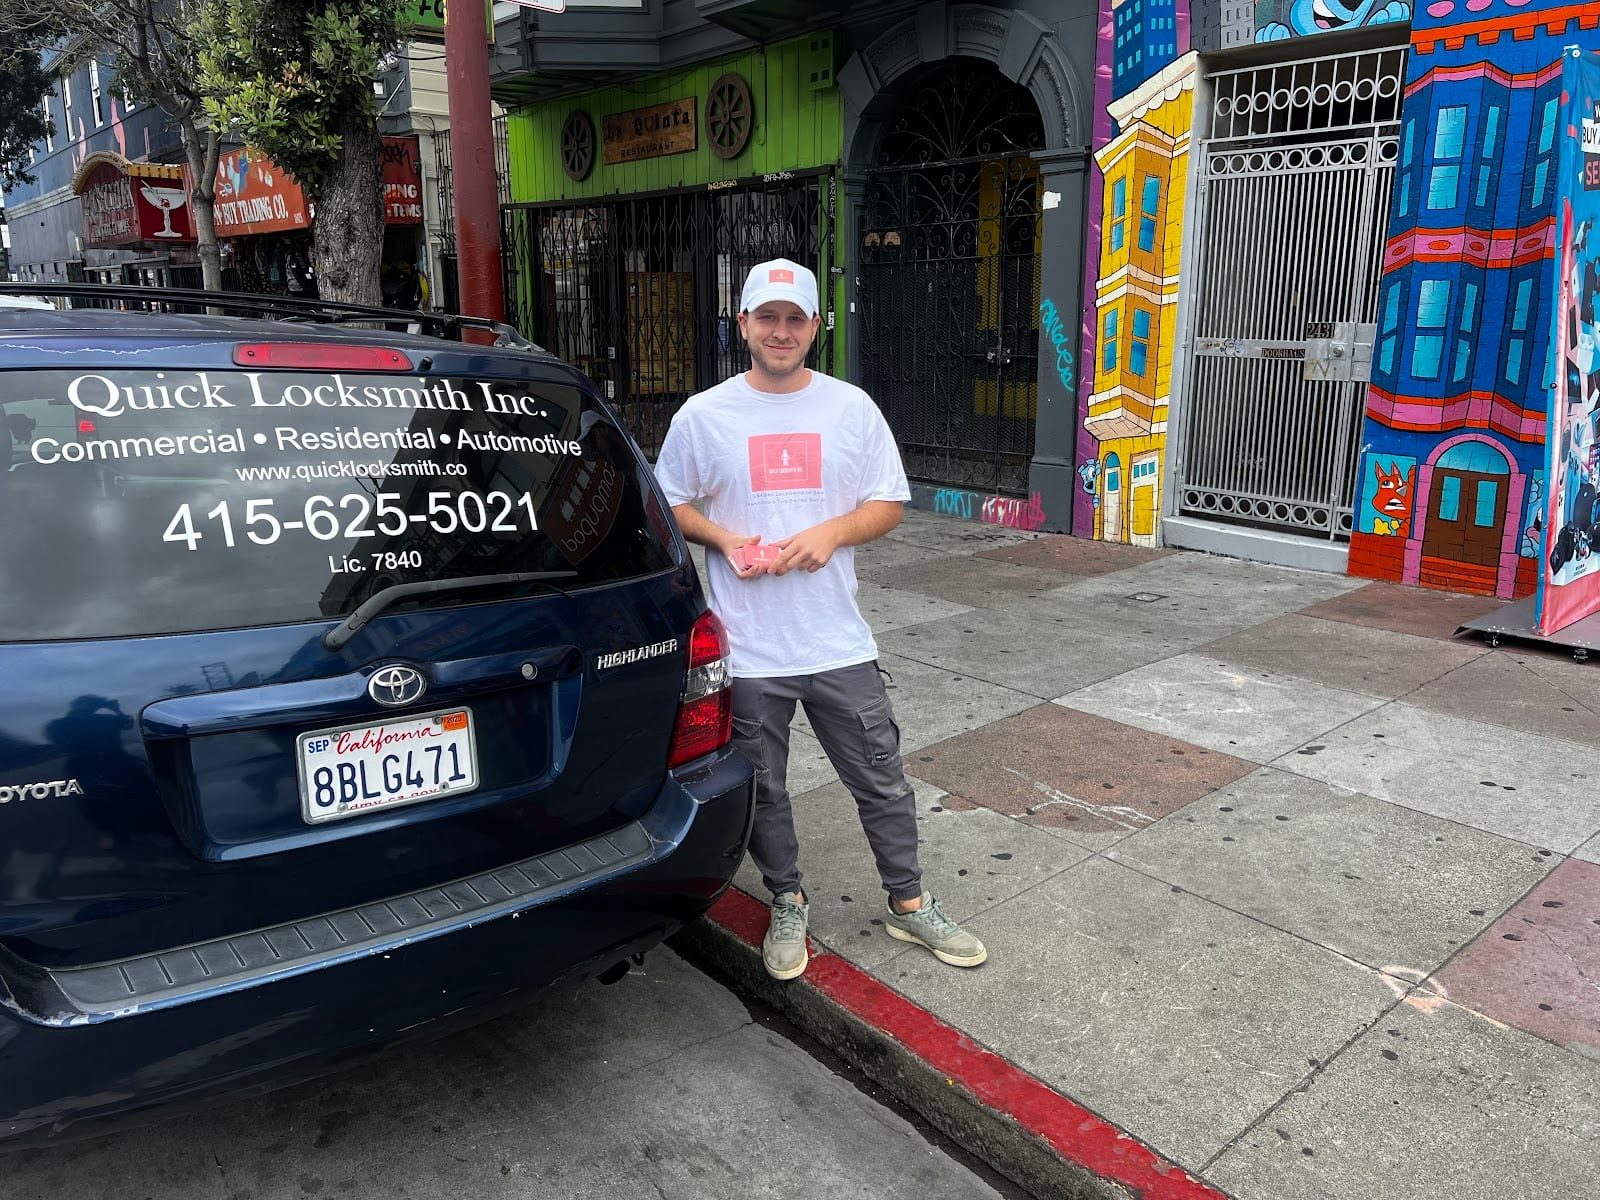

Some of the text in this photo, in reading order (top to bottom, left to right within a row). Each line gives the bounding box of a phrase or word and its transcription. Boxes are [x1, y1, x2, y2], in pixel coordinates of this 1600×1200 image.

[621, 141, 674, 157] RESTAURANT
[1583, 126, 1598, 144] BUY
[1585, 161, 1600, 186] SE
[222, 201, 239, 225] BUY
[236, 196, 273, 224] TRADING
[1307, 322, 1335, 338] 2431
[67, 372, 548, 418] Quick Locksmith Inc.
[31, 427, 583, 465] Commercial Residential Automotive
[235, 458, 468, 483] www.quicklocksmith.co
[162, 491, 539, 551] 415-625-5021
[328, 550, 422, 574] Lic. 7840
[597, 638, 678, 670] HIGHLANDER
[308, 725, 442, 755] SEP California
[313, 742, 466, 808] 8BLG471
